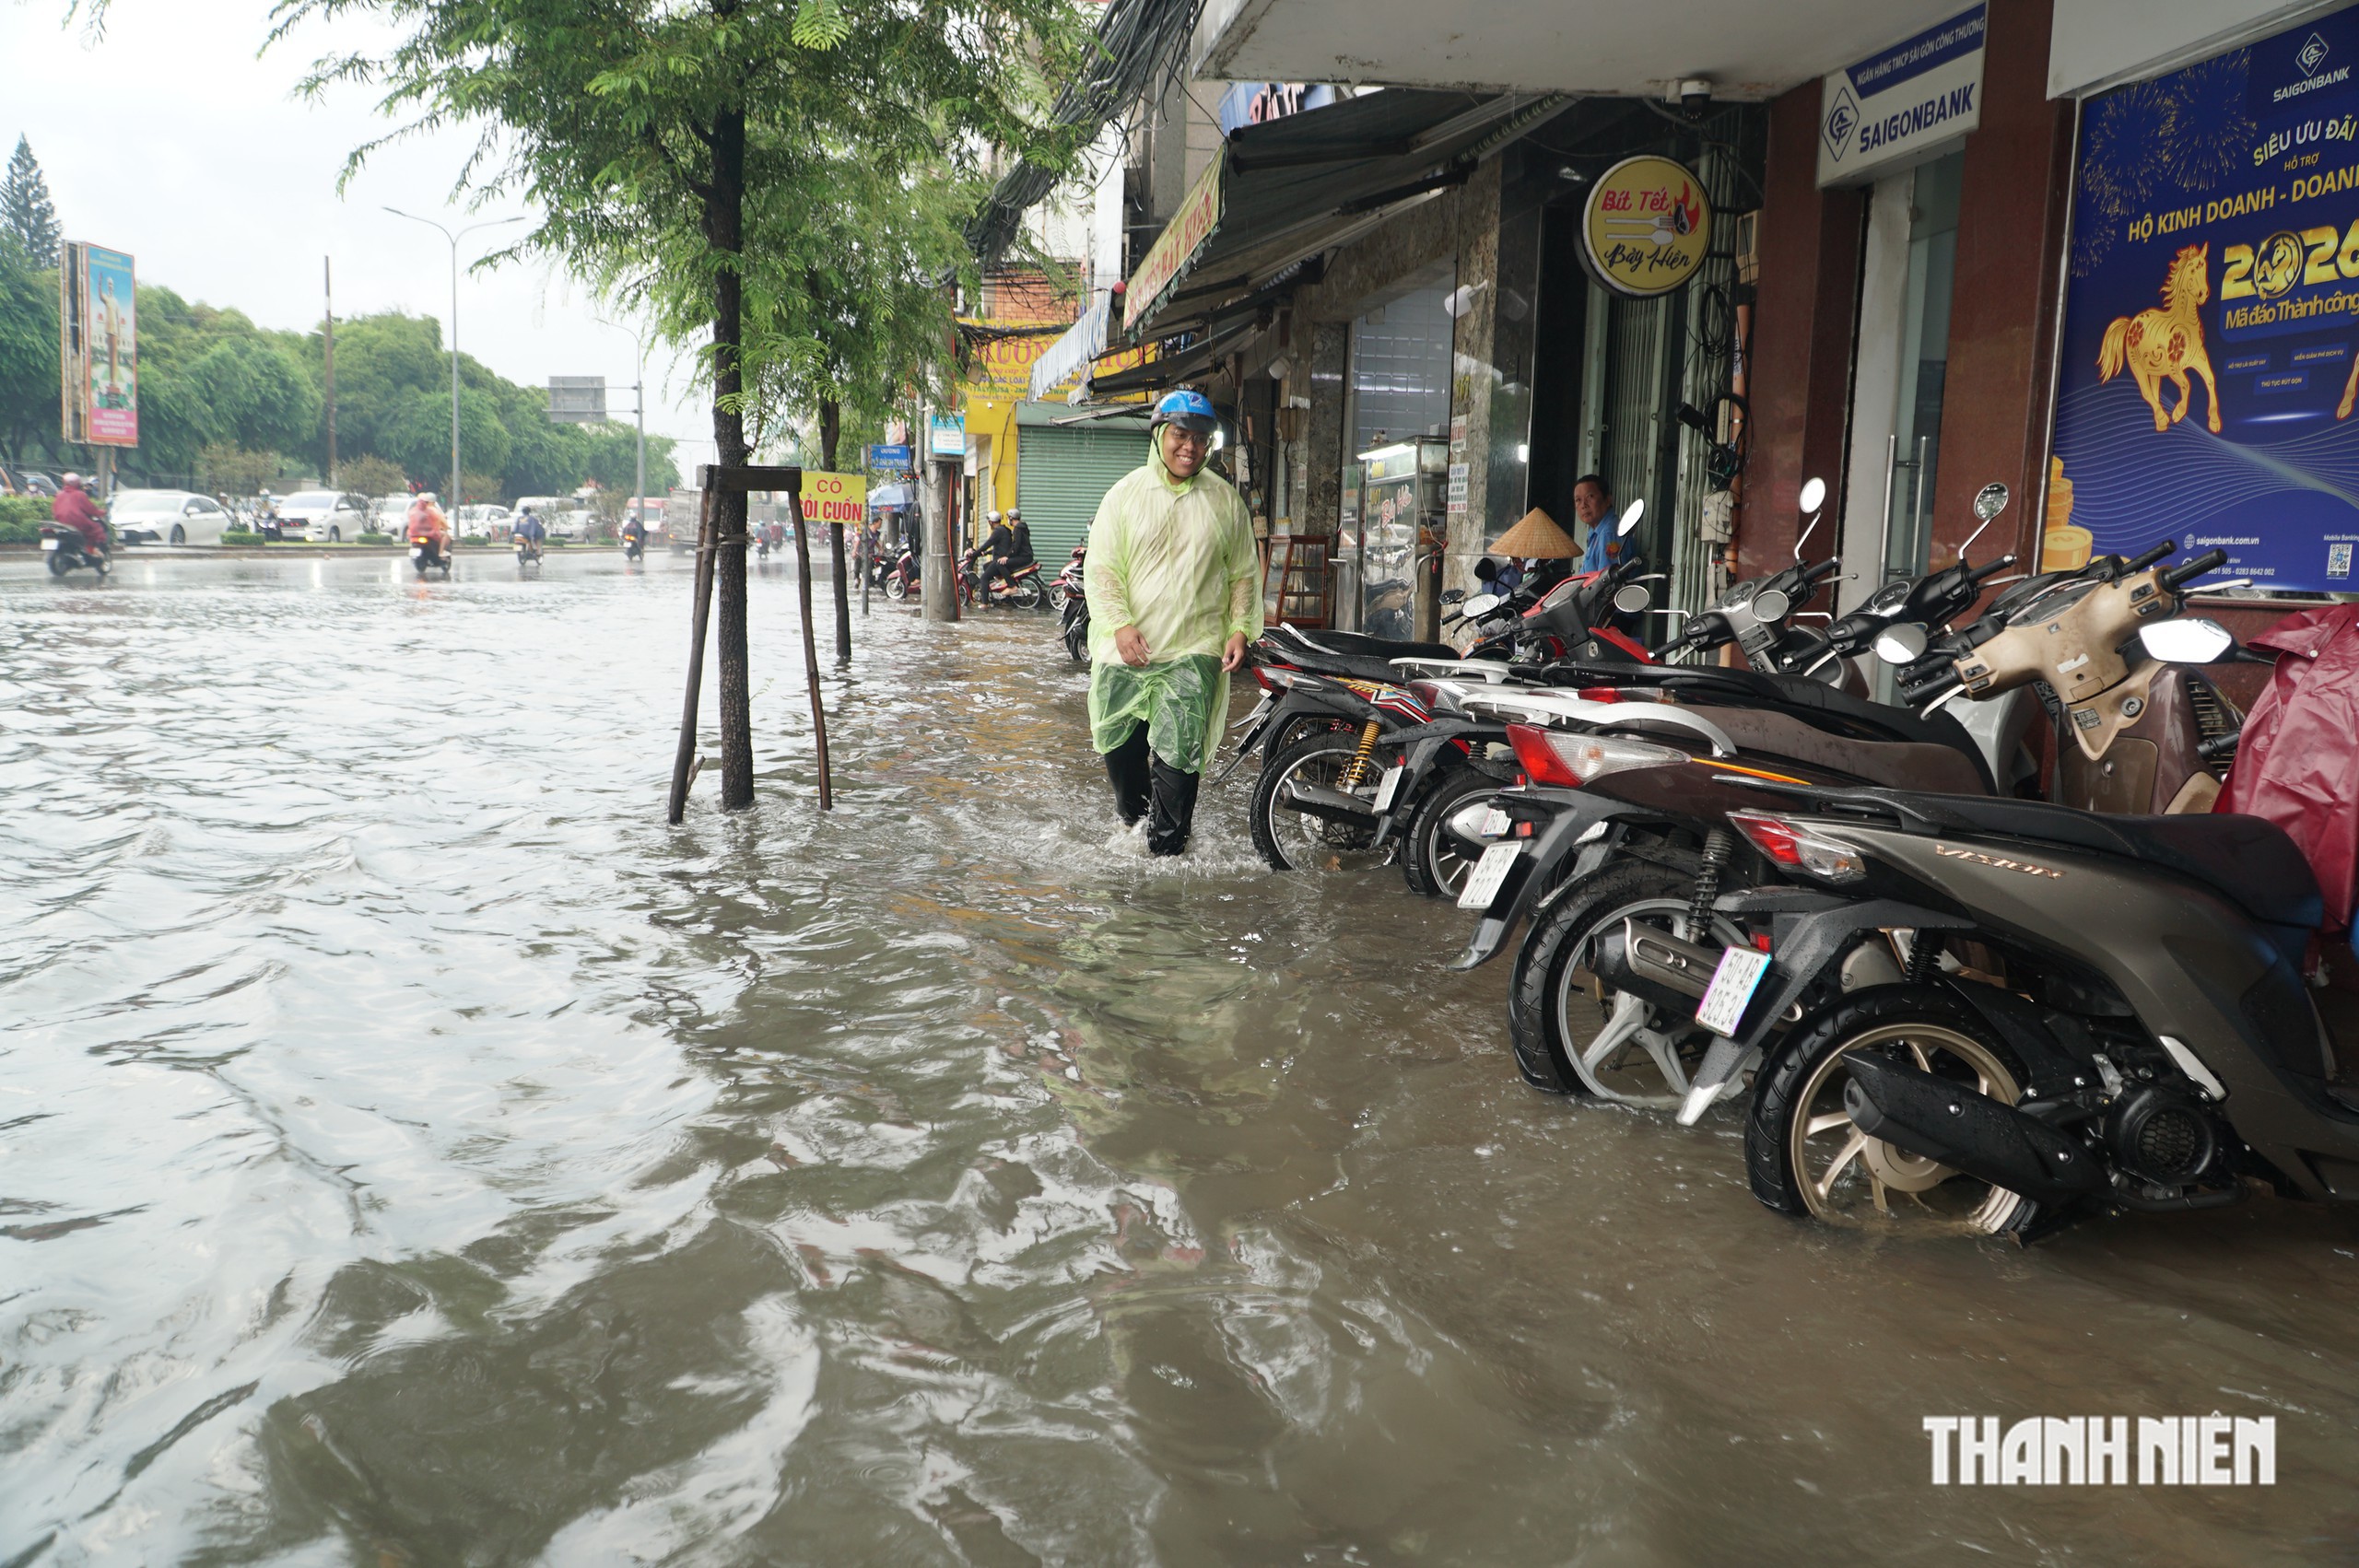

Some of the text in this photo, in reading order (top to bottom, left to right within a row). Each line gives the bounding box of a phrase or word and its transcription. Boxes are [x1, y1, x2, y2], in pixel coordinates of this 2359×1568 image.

[1857, 17, 1985, 87] NGÂN HÀNG TMCP SÀI GÒN CÔNG THƯƠNG
[2273, 65, 2351, 103] SAIGONBANK
[1860, 82, 1976, 153] SAIGONBANK
[2253, 114, 2358, 167] SIÊU ƯU ĐÃI
[2283, 151, 2320, 172] HỖ TRỢ
[1601, 186, 1672, 212] Bít Tết
[2128, 212, 2154, 243] HỘ
[2157, 205, 2201, 235] KINH
[2206, 186, 2275, 223] DOANH
[1604, 242, 1690, 273] Bảy Hiền
[2225, 290, 2359, 330] Mã đáo Thành công
[816, 477, 842, 494] CÓ
[800, 493, 863, 521] ỎI CUỐN
[2196, 535, 2259, 545] saigonbank.com.vn
[2249, 568, 2262, 576] 8642
[2263, 568, 2275, 576] 002
[1936, 844, 2067, 879] VISION
